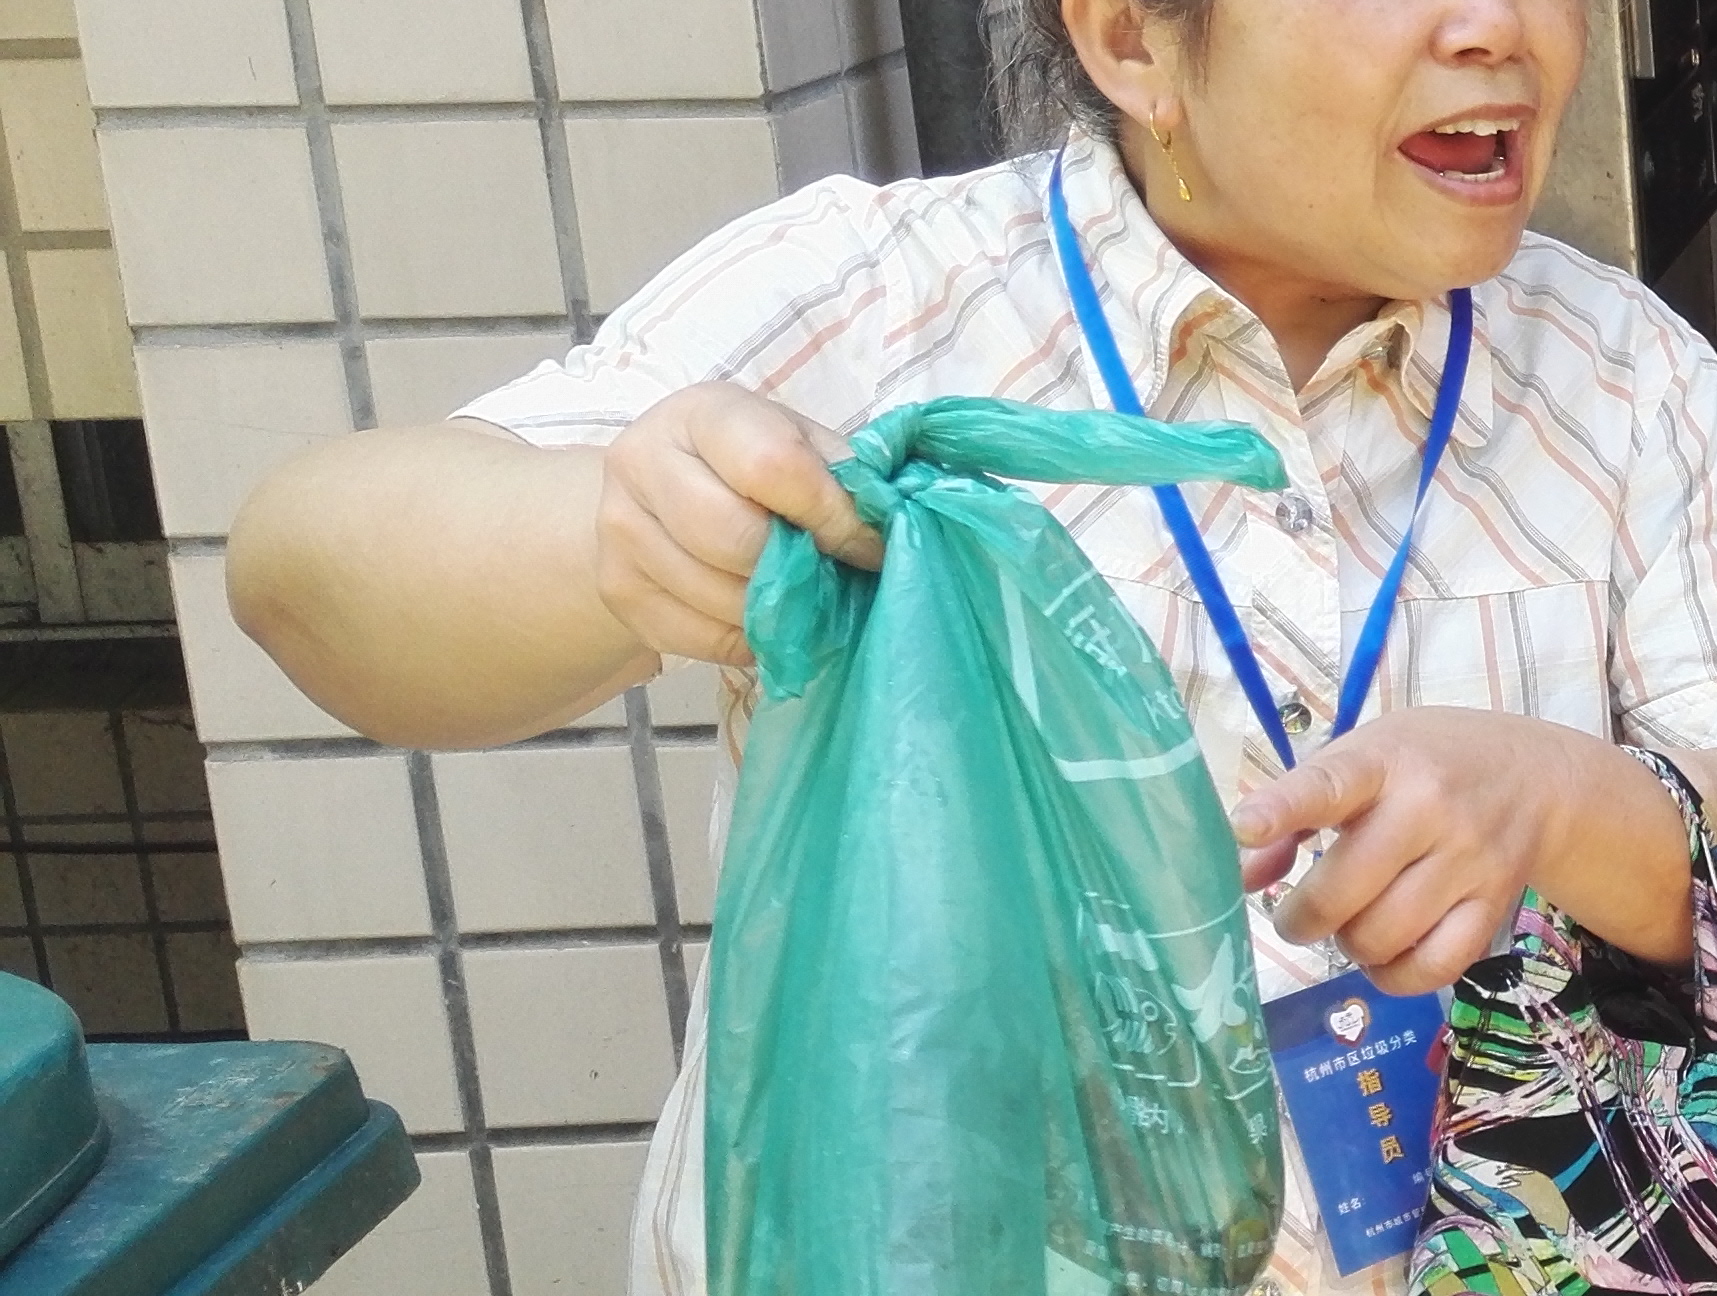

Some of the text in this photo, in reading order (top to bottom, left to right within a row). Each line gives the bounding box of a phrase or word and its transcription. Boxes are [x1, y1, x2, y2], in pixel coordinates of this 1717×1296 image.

[1304, 1030, 1418, 1083] 杭州市区垃圾分类
[1357, 1068, 1405, 1164] 指导员
